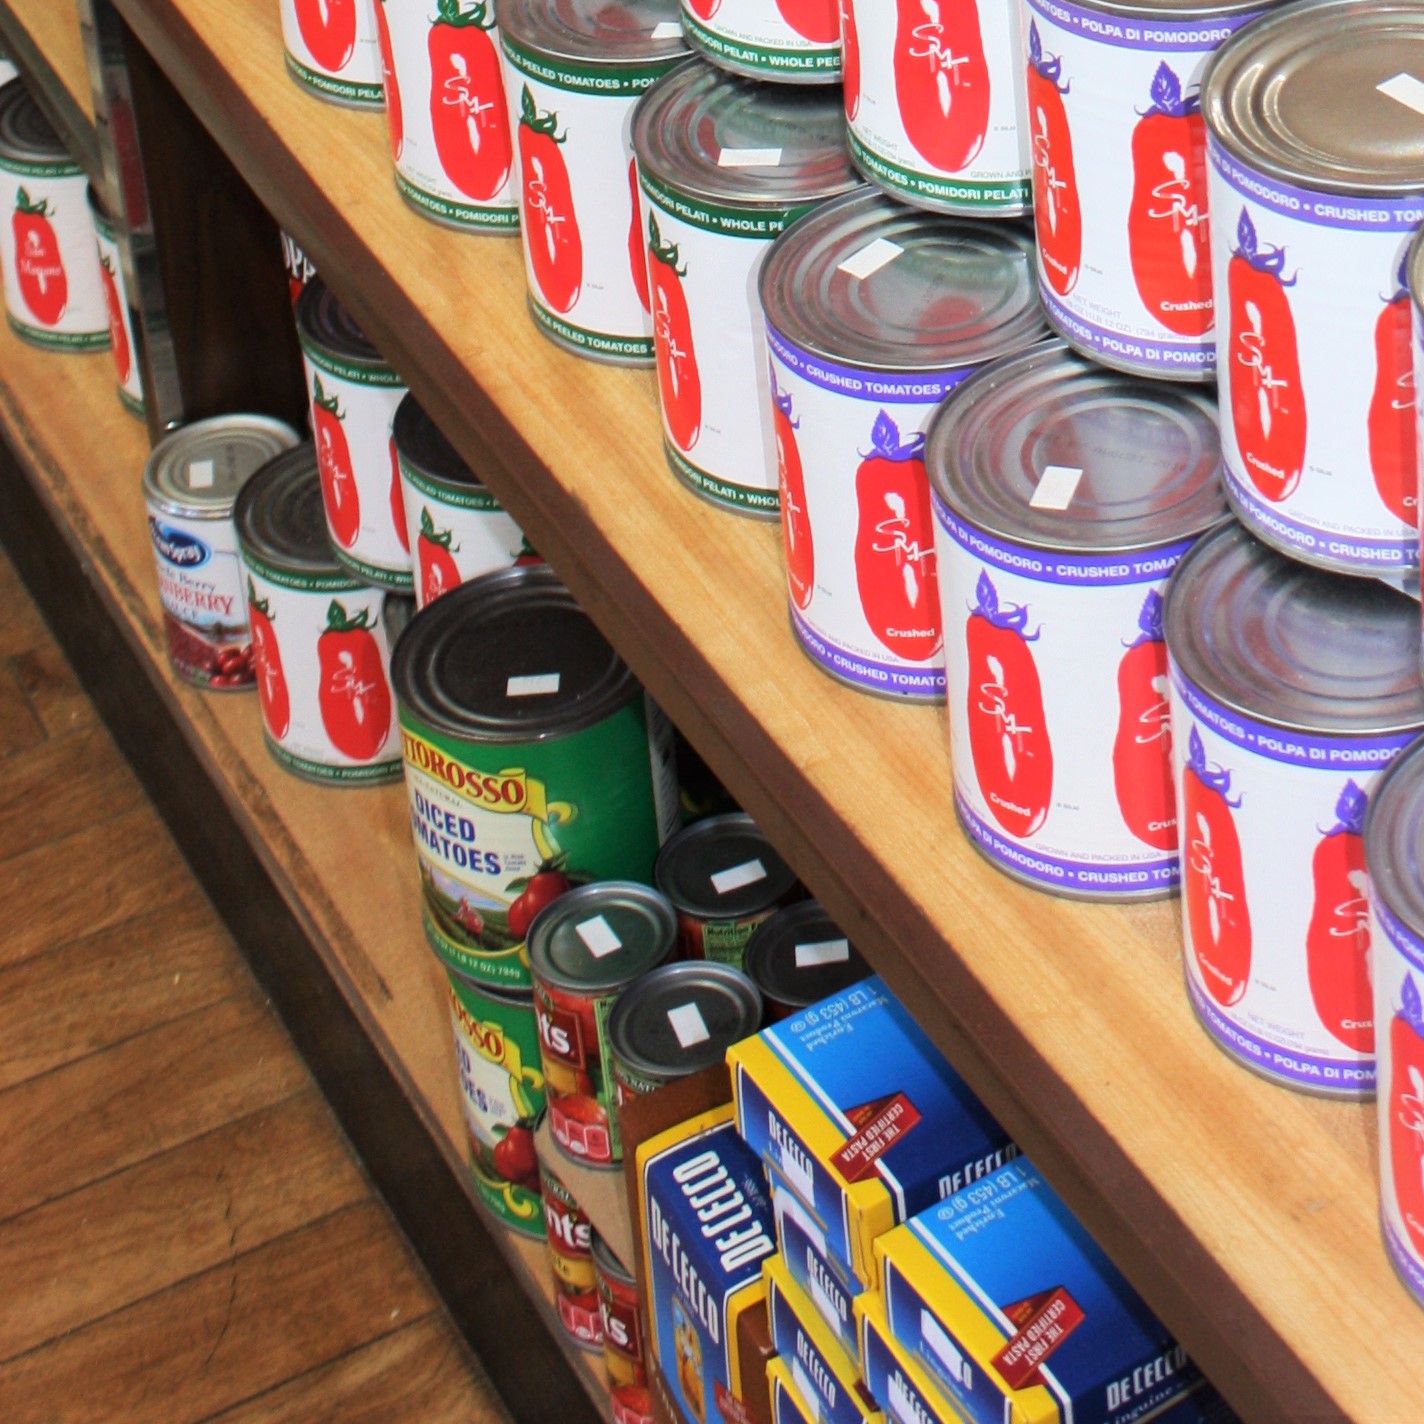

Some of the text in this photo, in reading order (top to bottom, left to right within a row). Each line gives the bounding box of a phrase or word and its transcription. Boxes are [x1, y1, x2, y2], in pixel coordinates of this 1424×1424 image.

[1081, 17, 1233, 45] POLPA DI POMODORO
[917, 179, 1029, 202] POMIDORI PELATI
[1313, 203, 1391, 222] CRUSHED
[1101, 336, 1144, 359] POLPA
[864, 381, 942, 397] TOMATOES
[965, 531, 1044, 572] POMODORO
[414, 788, 477, 844] DICED
[672, 1148, 776, 1274] DE CECCO
[651, 1195, 720, 1346] DE CECCO
